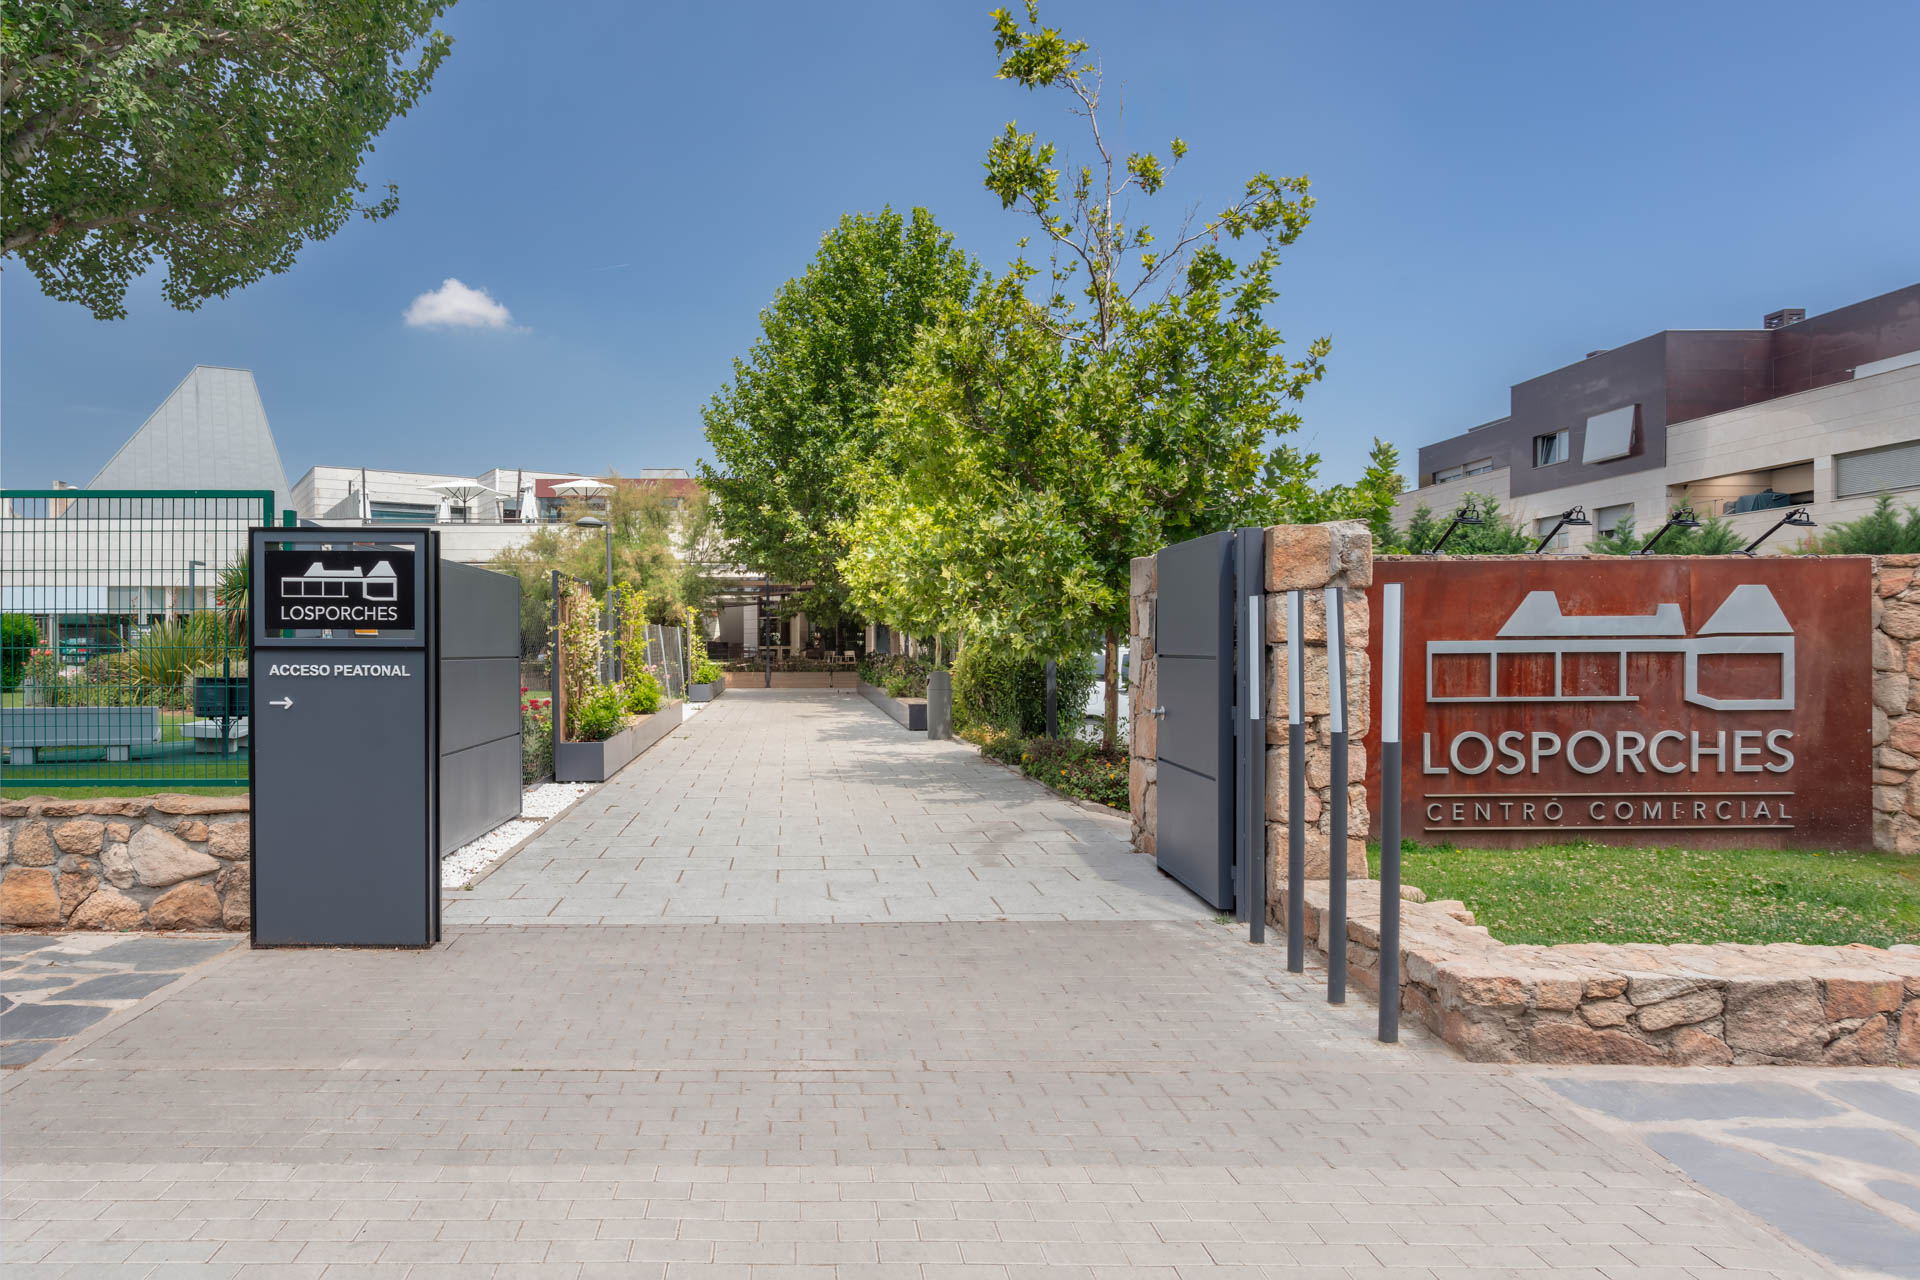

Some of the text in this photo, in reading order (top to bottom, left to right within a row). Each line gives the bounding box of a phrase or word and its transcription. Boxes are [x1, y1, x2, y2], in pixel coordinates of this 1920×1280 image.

[281, 606, 398, 621] LOSPORCHES
[269, 664, 411, 677] ACCESO PEATONAL
[1422, 729, 1795, 775] LOSPORCHES
[1427, 800, 1793, 822] CENTRO COMERCIAL
